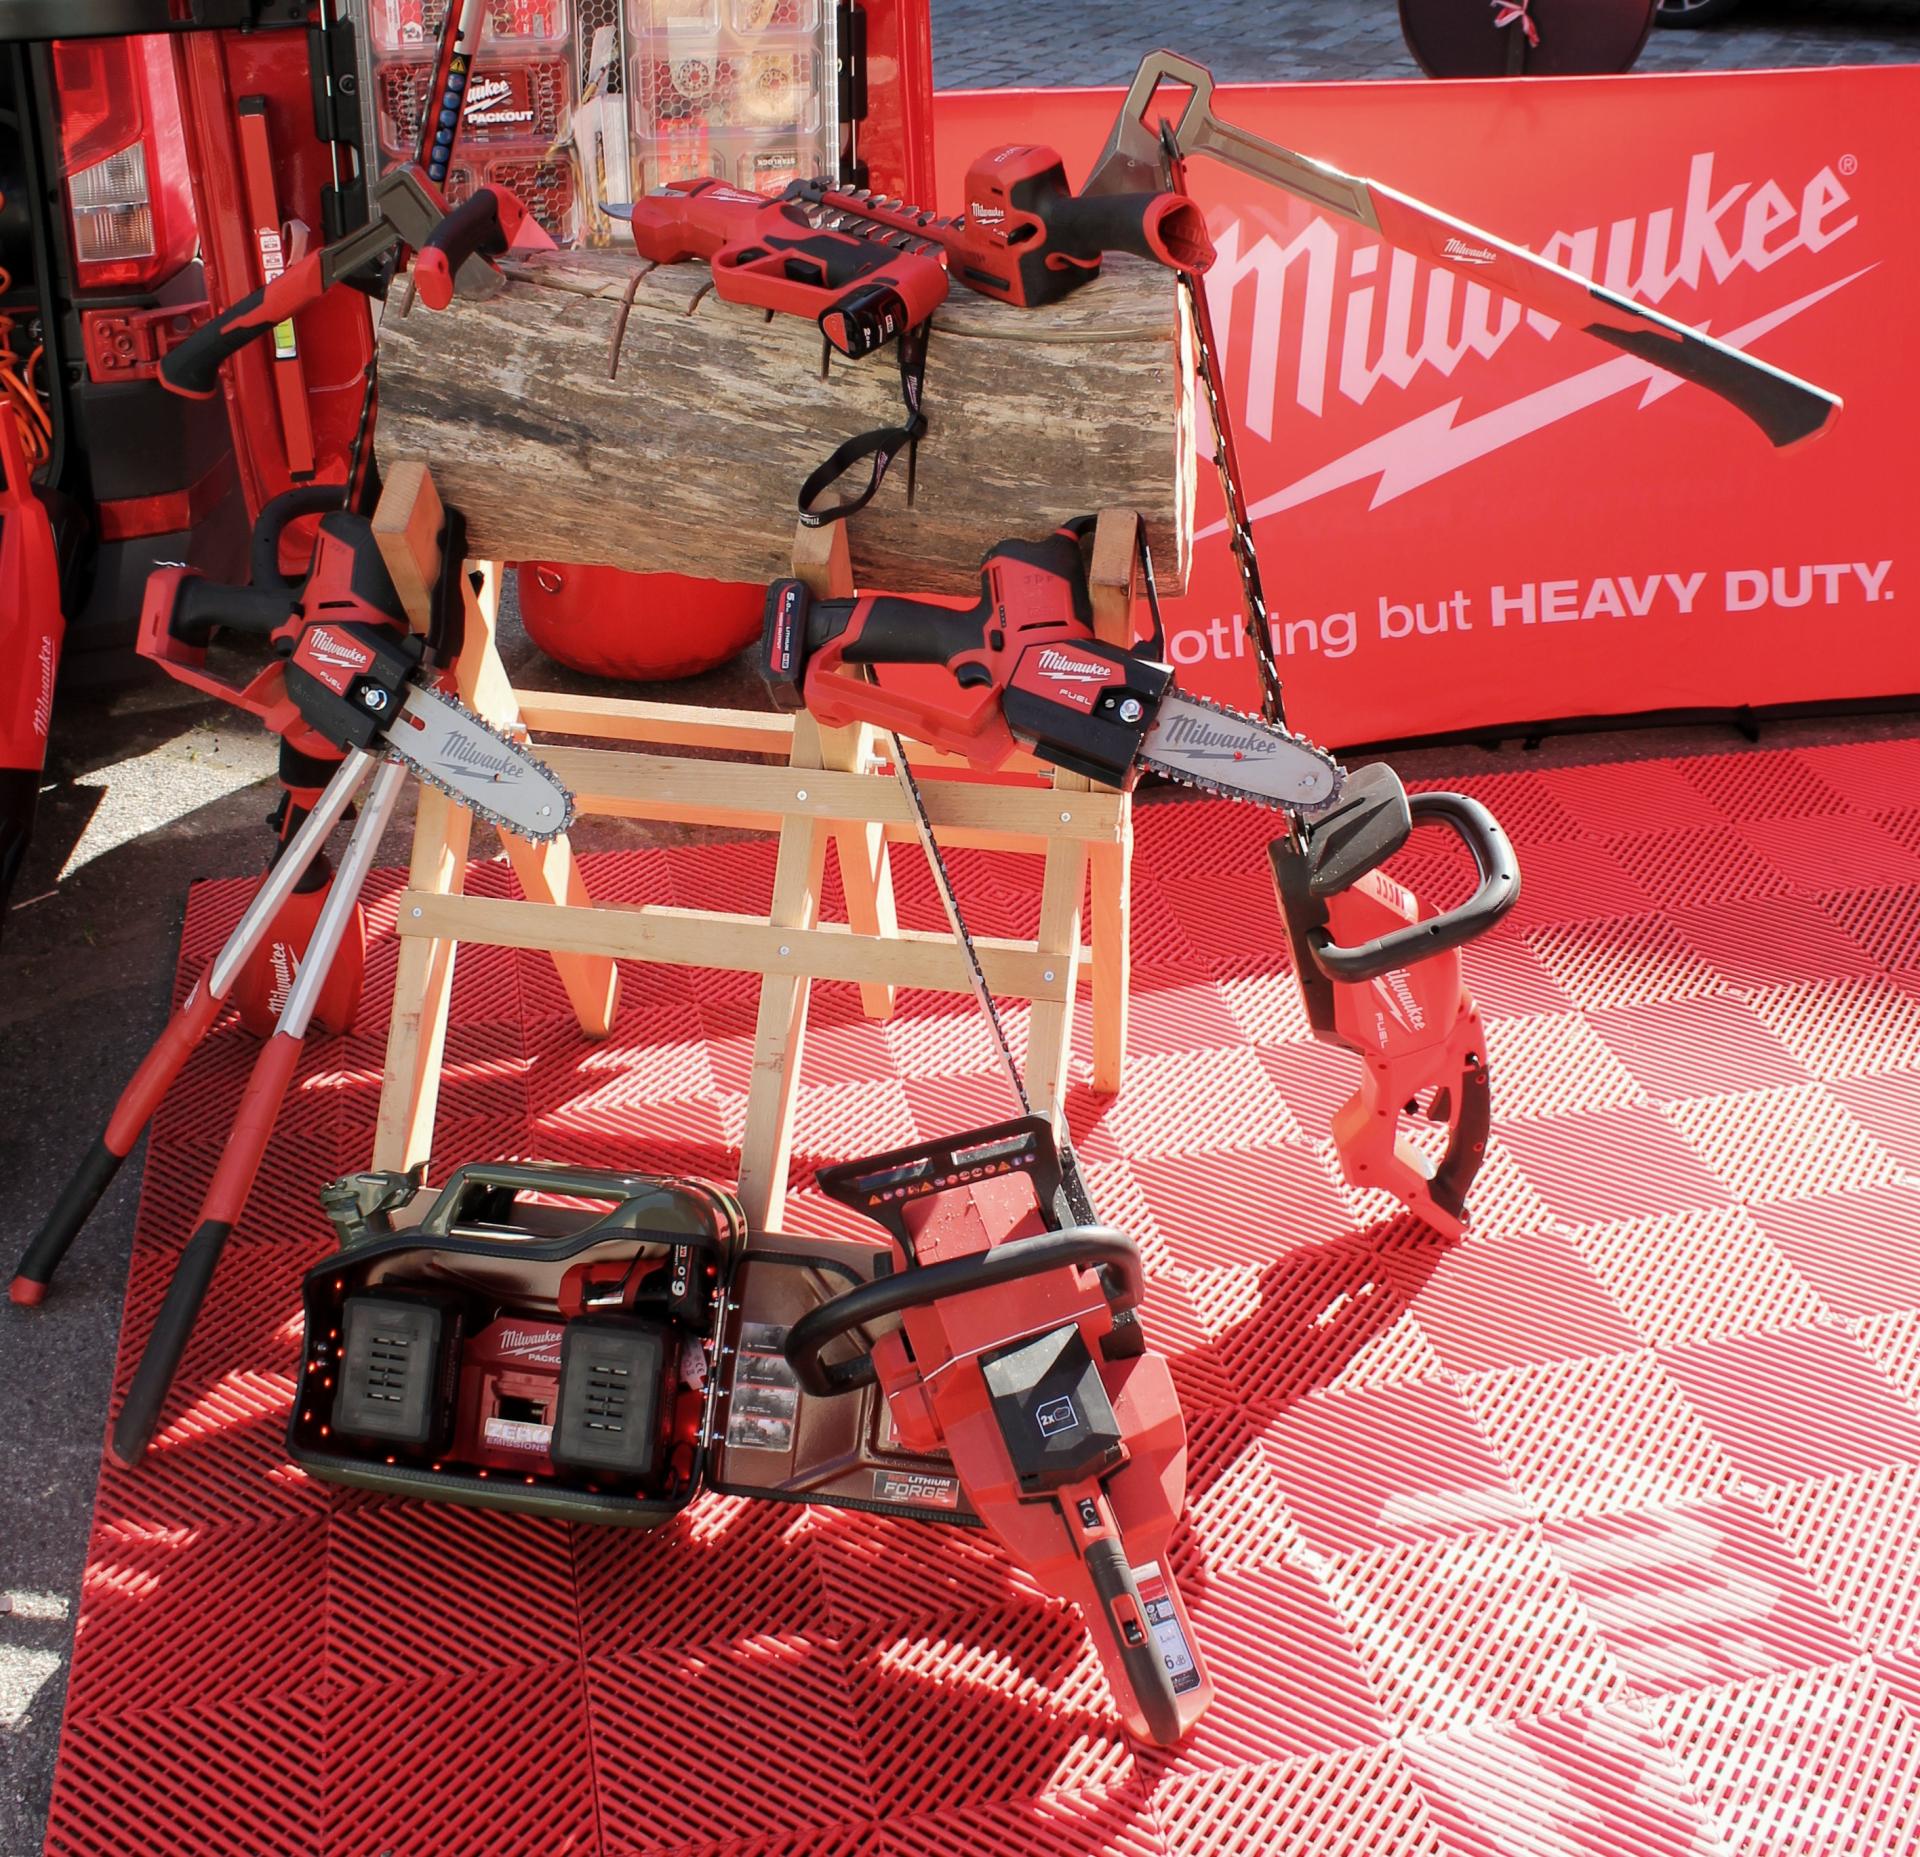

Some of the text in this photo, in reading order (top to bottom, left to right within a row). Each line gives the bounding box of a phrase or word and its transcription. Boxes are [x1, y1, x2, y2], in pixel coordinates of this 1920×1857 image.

[468, 111, 534, 124] PACKOUT
[757, 155, 797, 167] STARLOCK
[1443, 237, 1497, 261] Milwaukee
[1378, 590, 1473, 640] but
[1490, 572, 1707, 627] HEAVY
[1725, 560, 1895, 612] DUTY.
[310, 627, 367, 665] Milwaukee
[1038, 649, 1112, 677] Milwaukee
[32, 635, 51, 737] Milwaukee
[319, 670, 344, 691] FUEL
[1060, 688, 1092, 706] FUEL
[1164, 713, 1277, 755] Milwaukee
[440, 729, 524, 778] Milwaukee
[1386, 967, 1427, 1032] ilwaukee
[1375, 1011, 1389, 1049] FUEL
[671, 1266, 686, 1297] 6.0
[499, 1328, 562, 1350] Milwaukee
[1040, 1413, 1055, 1426] 2x
[486, 1422, 551, 1444] ZERO
[486, 1436, 548, 1453] EMISSIONS
[884, 1481, 949, 1499] FORGE
